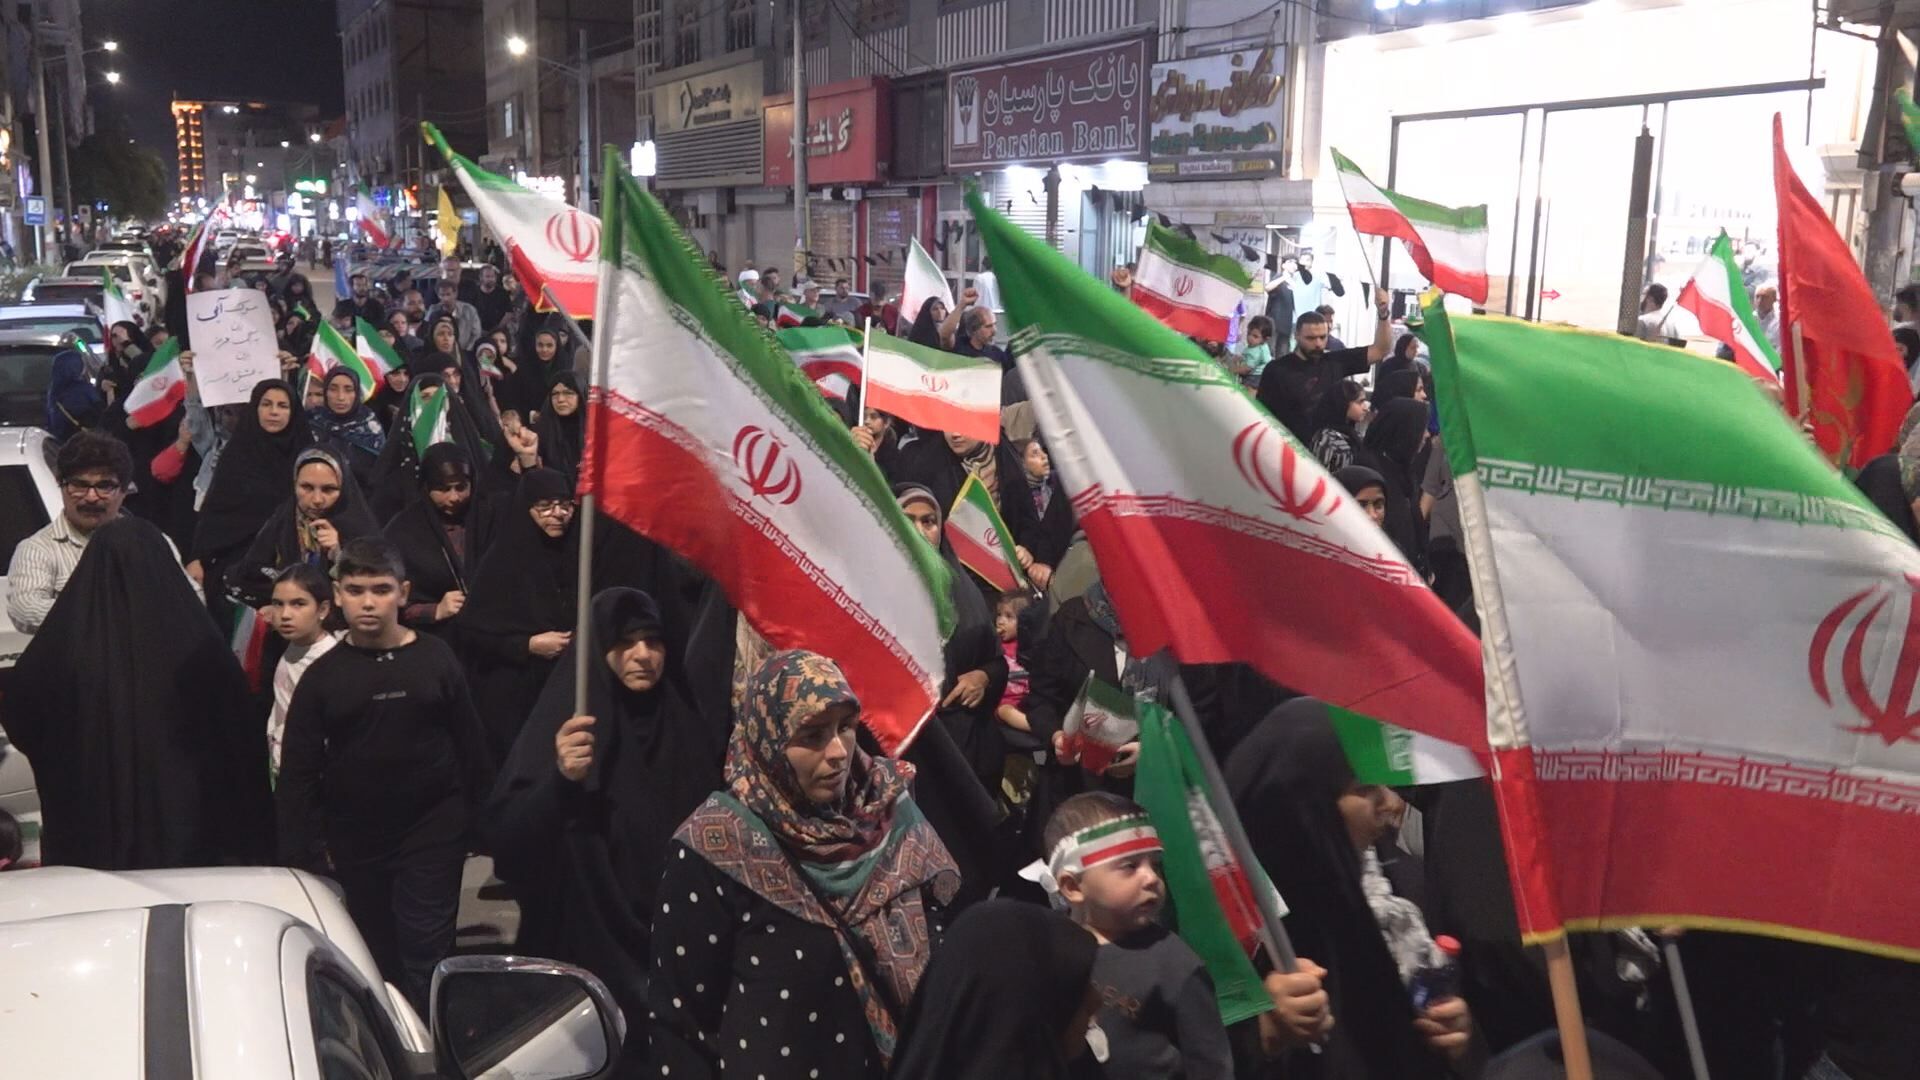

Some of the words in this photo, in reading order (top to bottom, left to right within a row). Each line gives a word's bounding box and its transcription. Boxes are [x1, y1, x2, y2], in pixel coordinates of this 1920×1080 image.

[982, 68, 1065, 127] پارسیان
[1069, 52, 1139, 111] بانک
[982, 128, 1064, 160] Parsian
[1072, 115, 1136, 153] Bank
